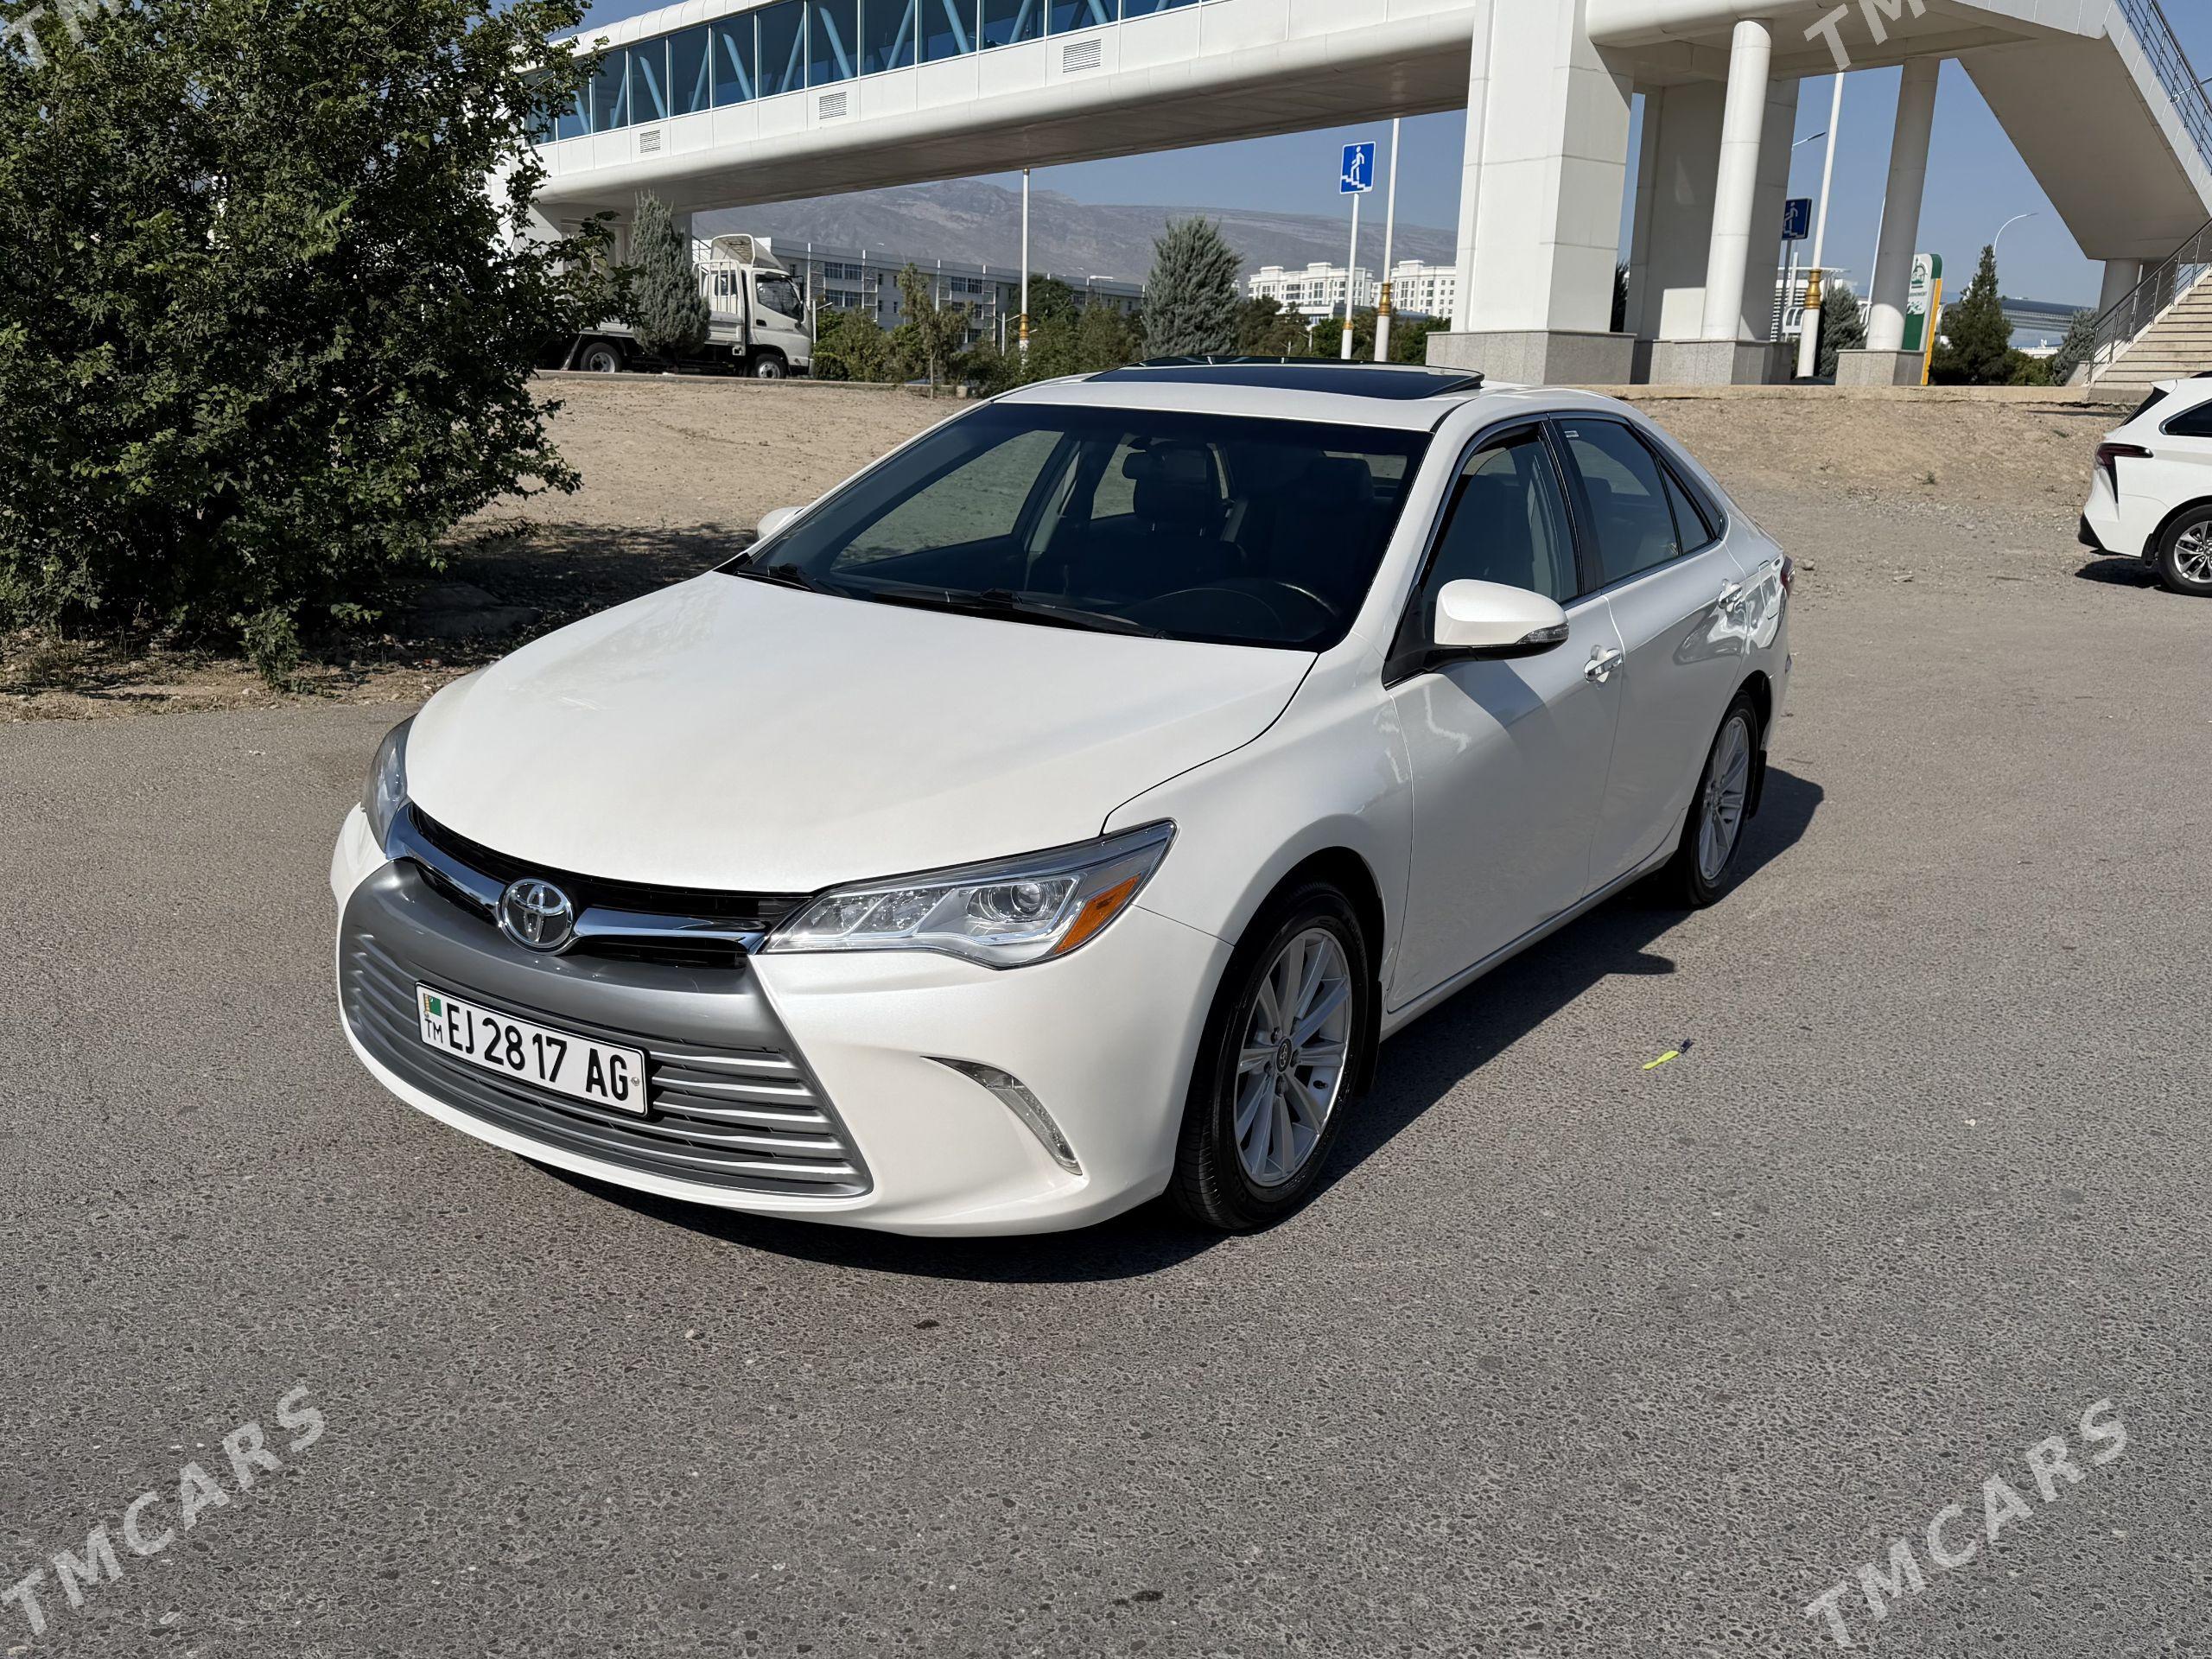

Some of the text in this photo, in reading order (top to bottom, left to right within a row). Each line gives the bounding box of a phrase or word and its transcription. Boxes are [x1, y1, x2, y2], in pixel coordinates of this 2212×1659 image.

[424, 1019, 443, 1044] TM
[447, 1002, 474, 1054] EJ
[585, 1048, 629, 1102] AG
